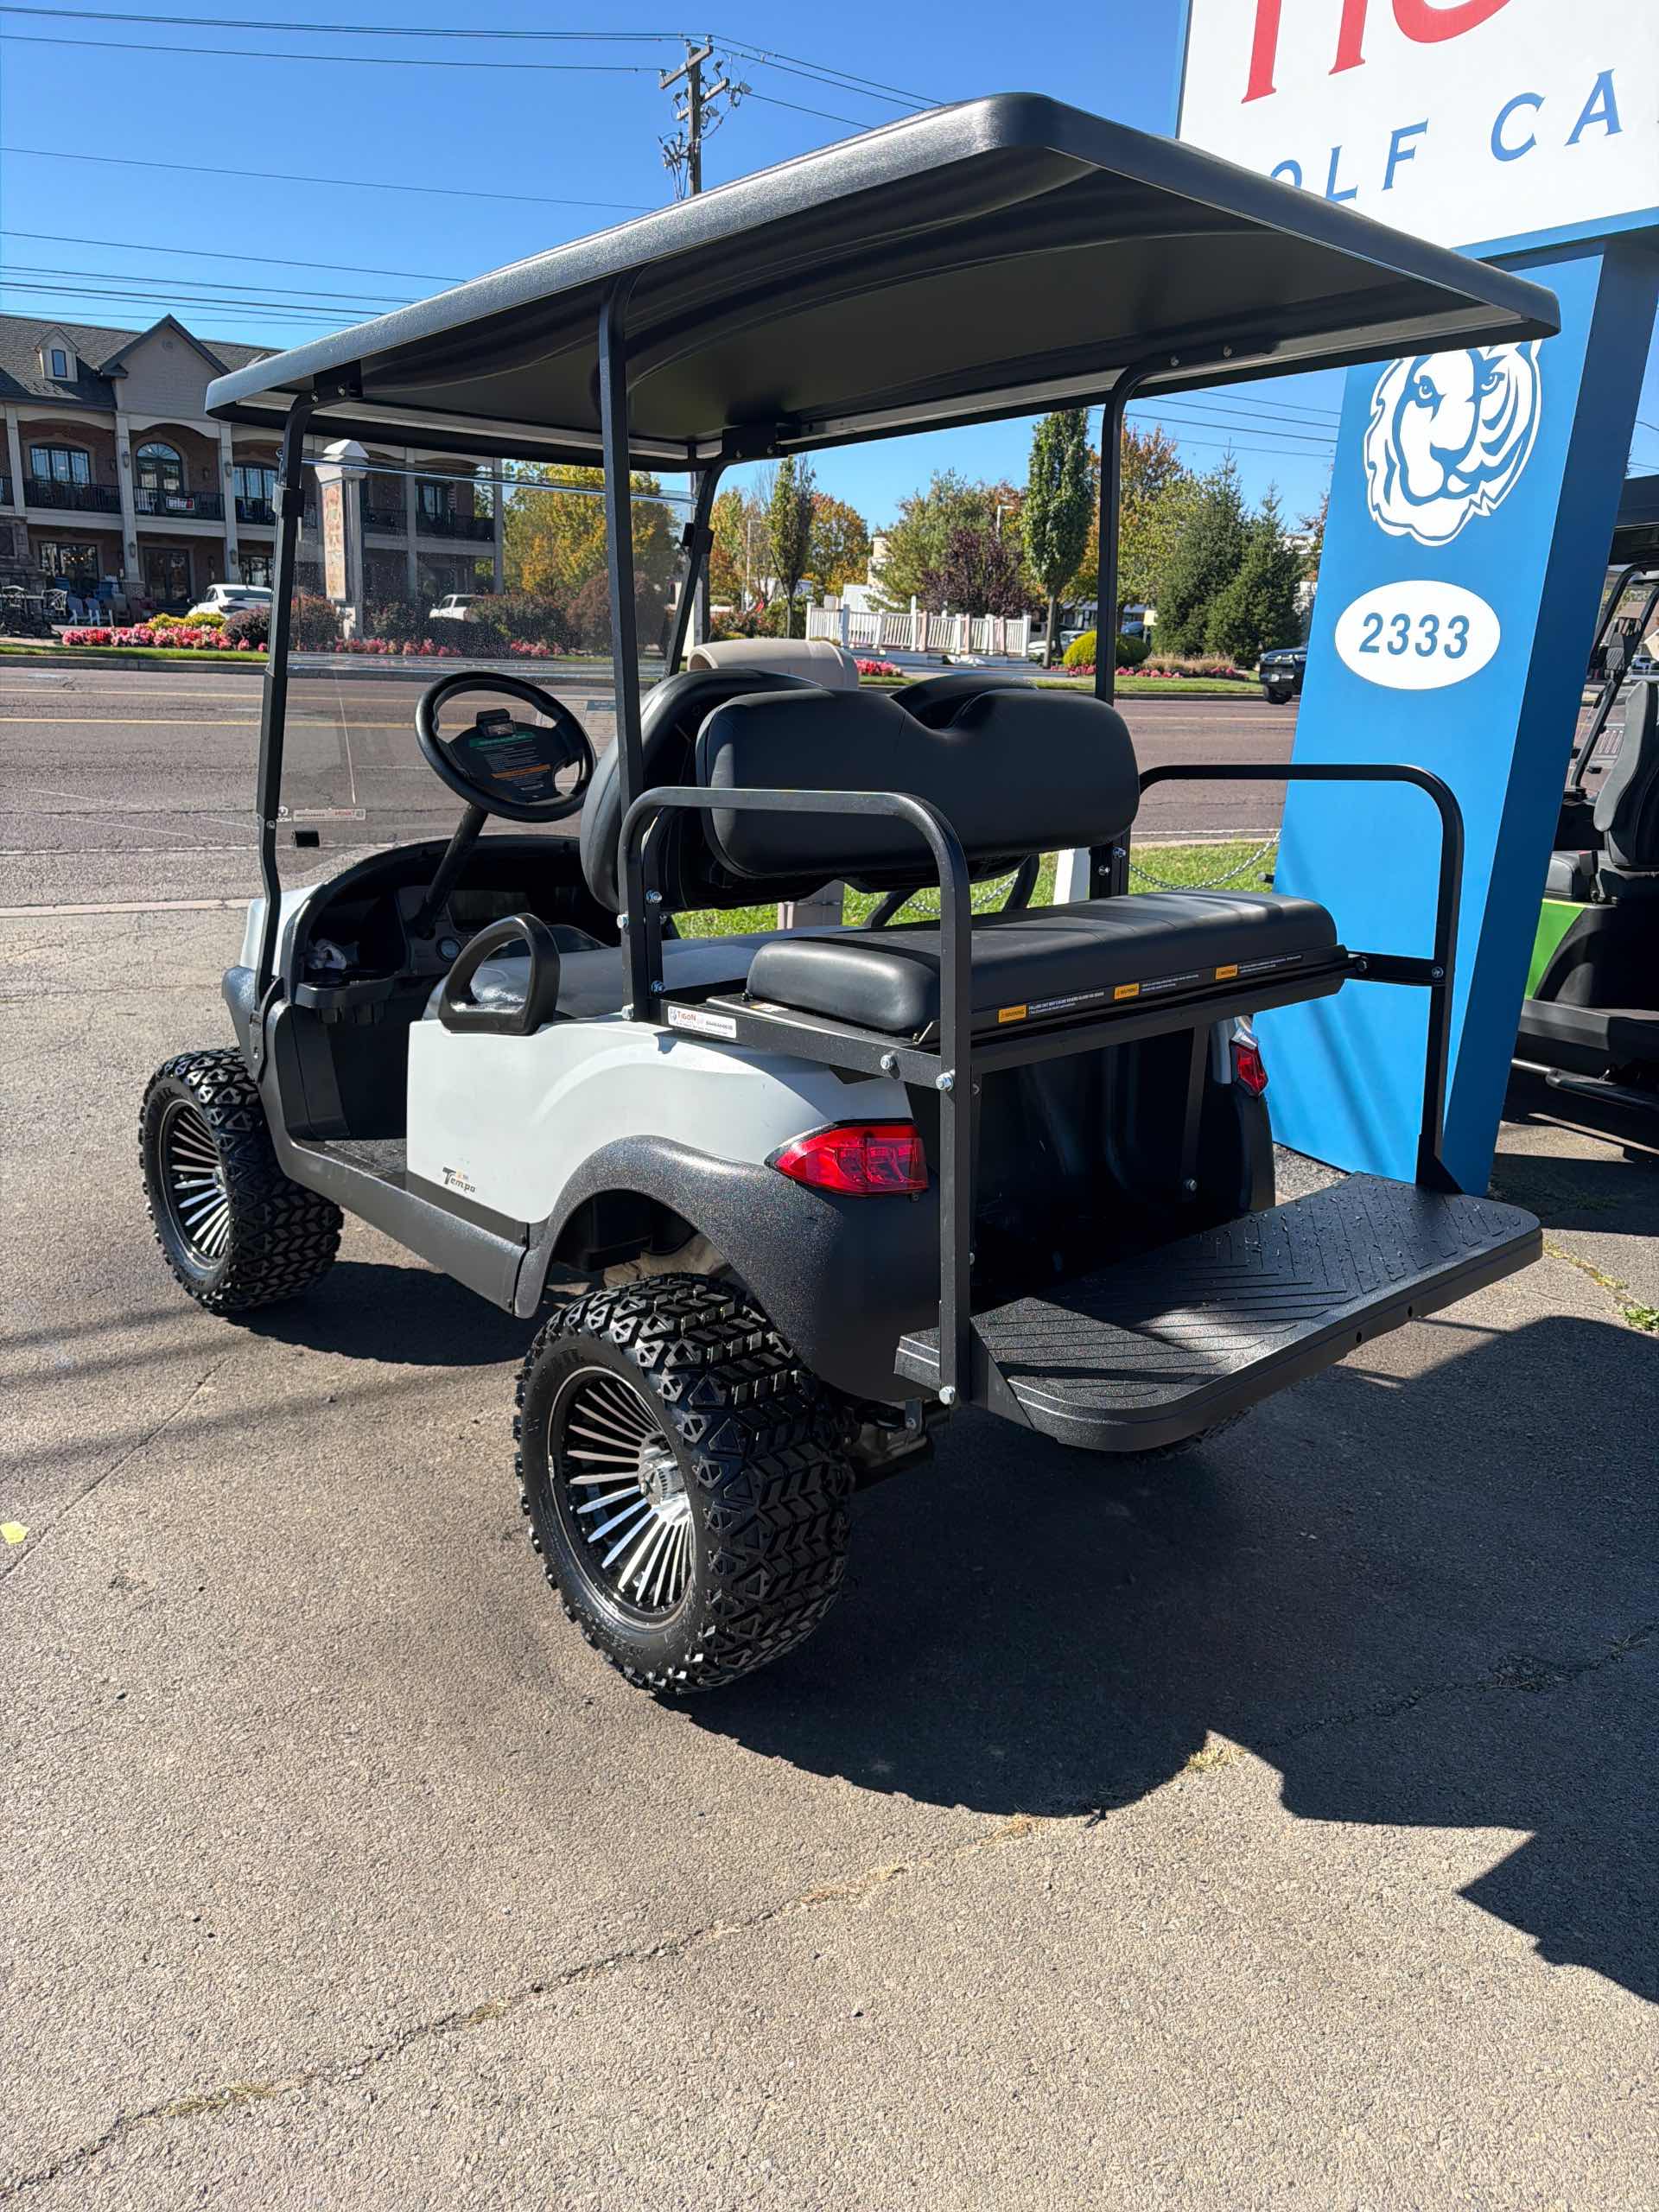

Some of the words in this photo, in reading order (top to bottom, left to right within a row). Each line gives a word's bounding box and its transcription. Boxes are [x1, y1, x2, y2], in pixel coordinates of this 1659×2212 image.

[1491, 68, 1624, 162] CA
[1359, 612, 1470, 659] 2333
[442, 1166, 476, 1193] Tempo
